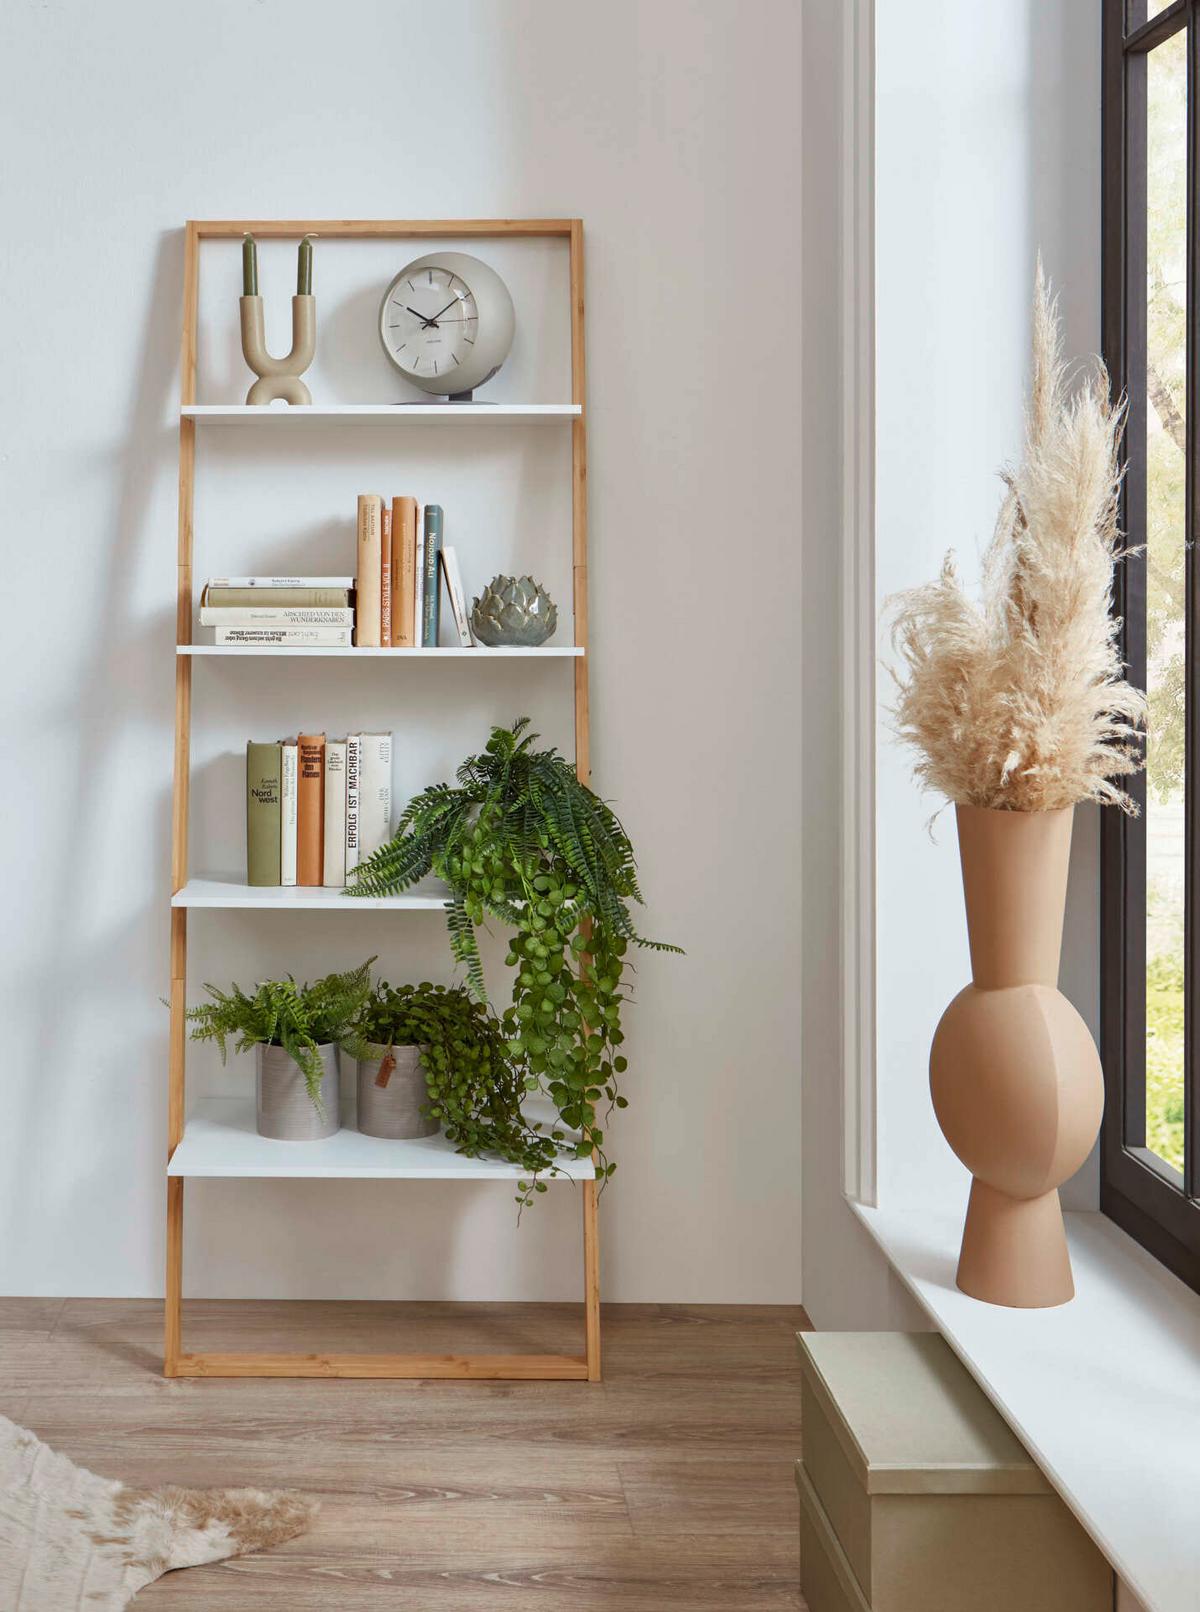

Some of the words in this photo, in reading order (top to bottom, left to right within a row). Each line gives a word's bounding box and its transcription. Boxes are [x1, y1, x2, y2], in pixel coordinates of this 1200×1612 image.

[382, 585, 390, 607] STYLE
[382, 608, 390, 628] PARIS
[348, 742, 358, 790] MACHBAR
[251, 788, 272, 797] Nord
[258, 796, 278, 804] west
[348, 793, 358, 809] IST
[347, 813, 357, 849] ERFOLG
